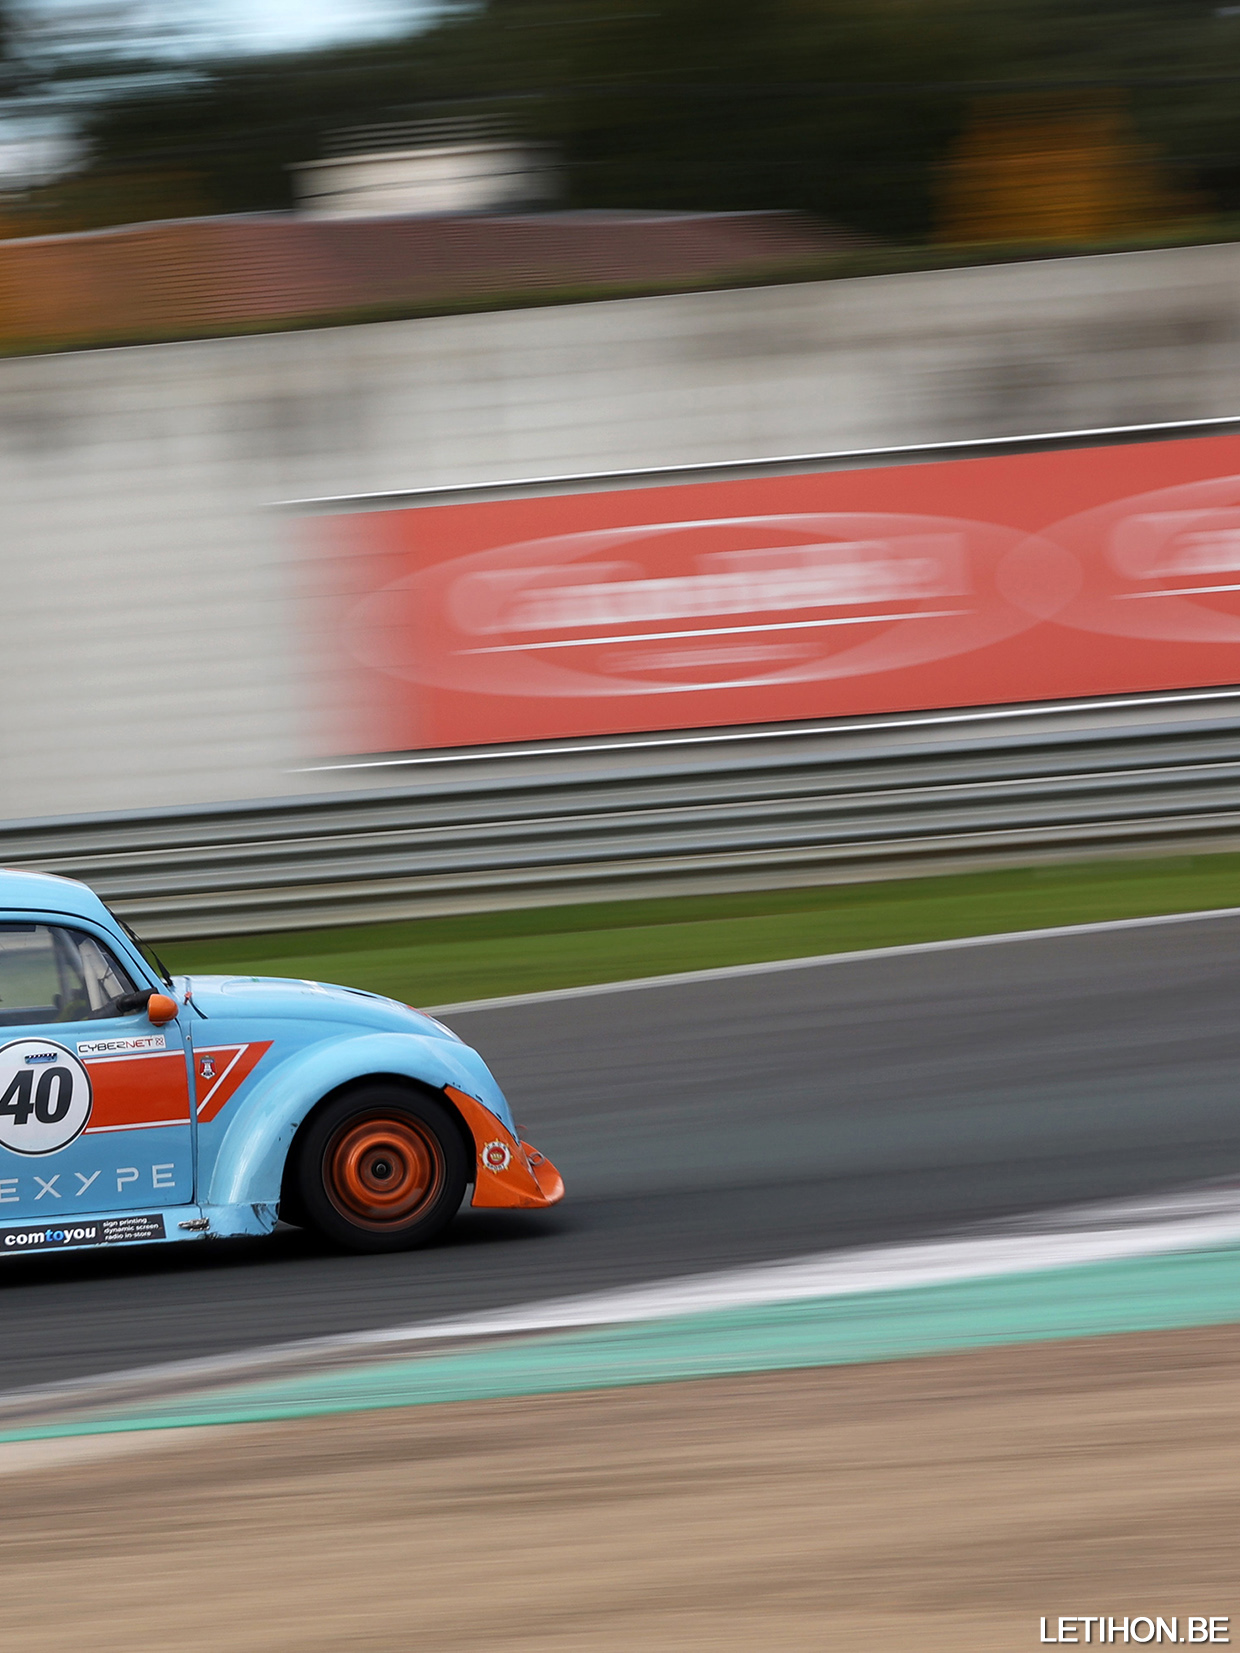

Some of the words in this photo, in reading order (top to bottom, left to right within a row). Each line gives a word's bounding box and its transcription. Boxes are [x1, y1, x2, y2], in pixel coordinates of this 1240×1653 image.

[78, 1038, 154, 1053] CYBERNET
[119, 1217, 148, 1226] printing
[103, 1225, 135, 1234] dynamic
[136, 1223, 159, 1231] screen
[4, 1227, 97, 1247] comtoyou
[105, 1232, 124, 1240] radio
